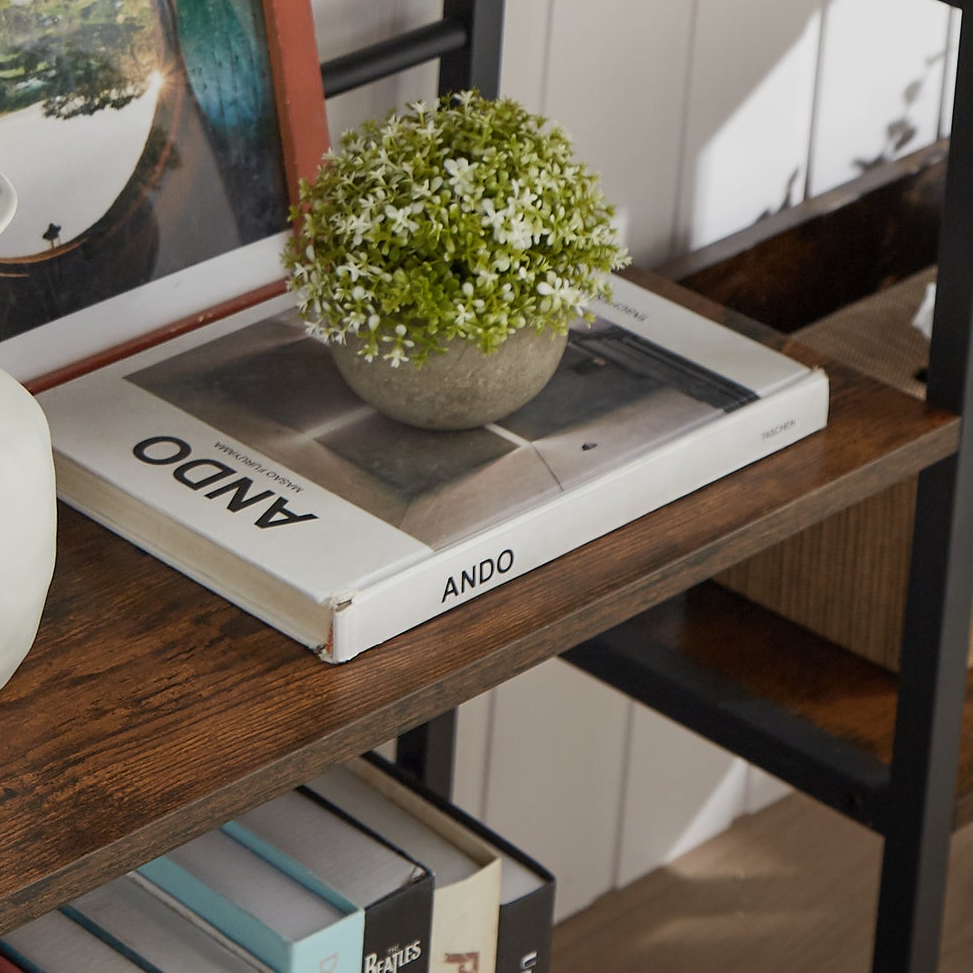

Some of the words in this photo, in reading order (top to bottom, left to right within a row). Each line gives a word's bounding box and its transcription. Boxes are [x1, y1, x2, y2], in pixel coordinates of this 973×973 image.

[132, 435, 319, 529] ANDO
[266, 470, 304, 494] MASAO
[441, 548, 514, 604] ANDO
[364, 940, 422, 973] BEATLES
